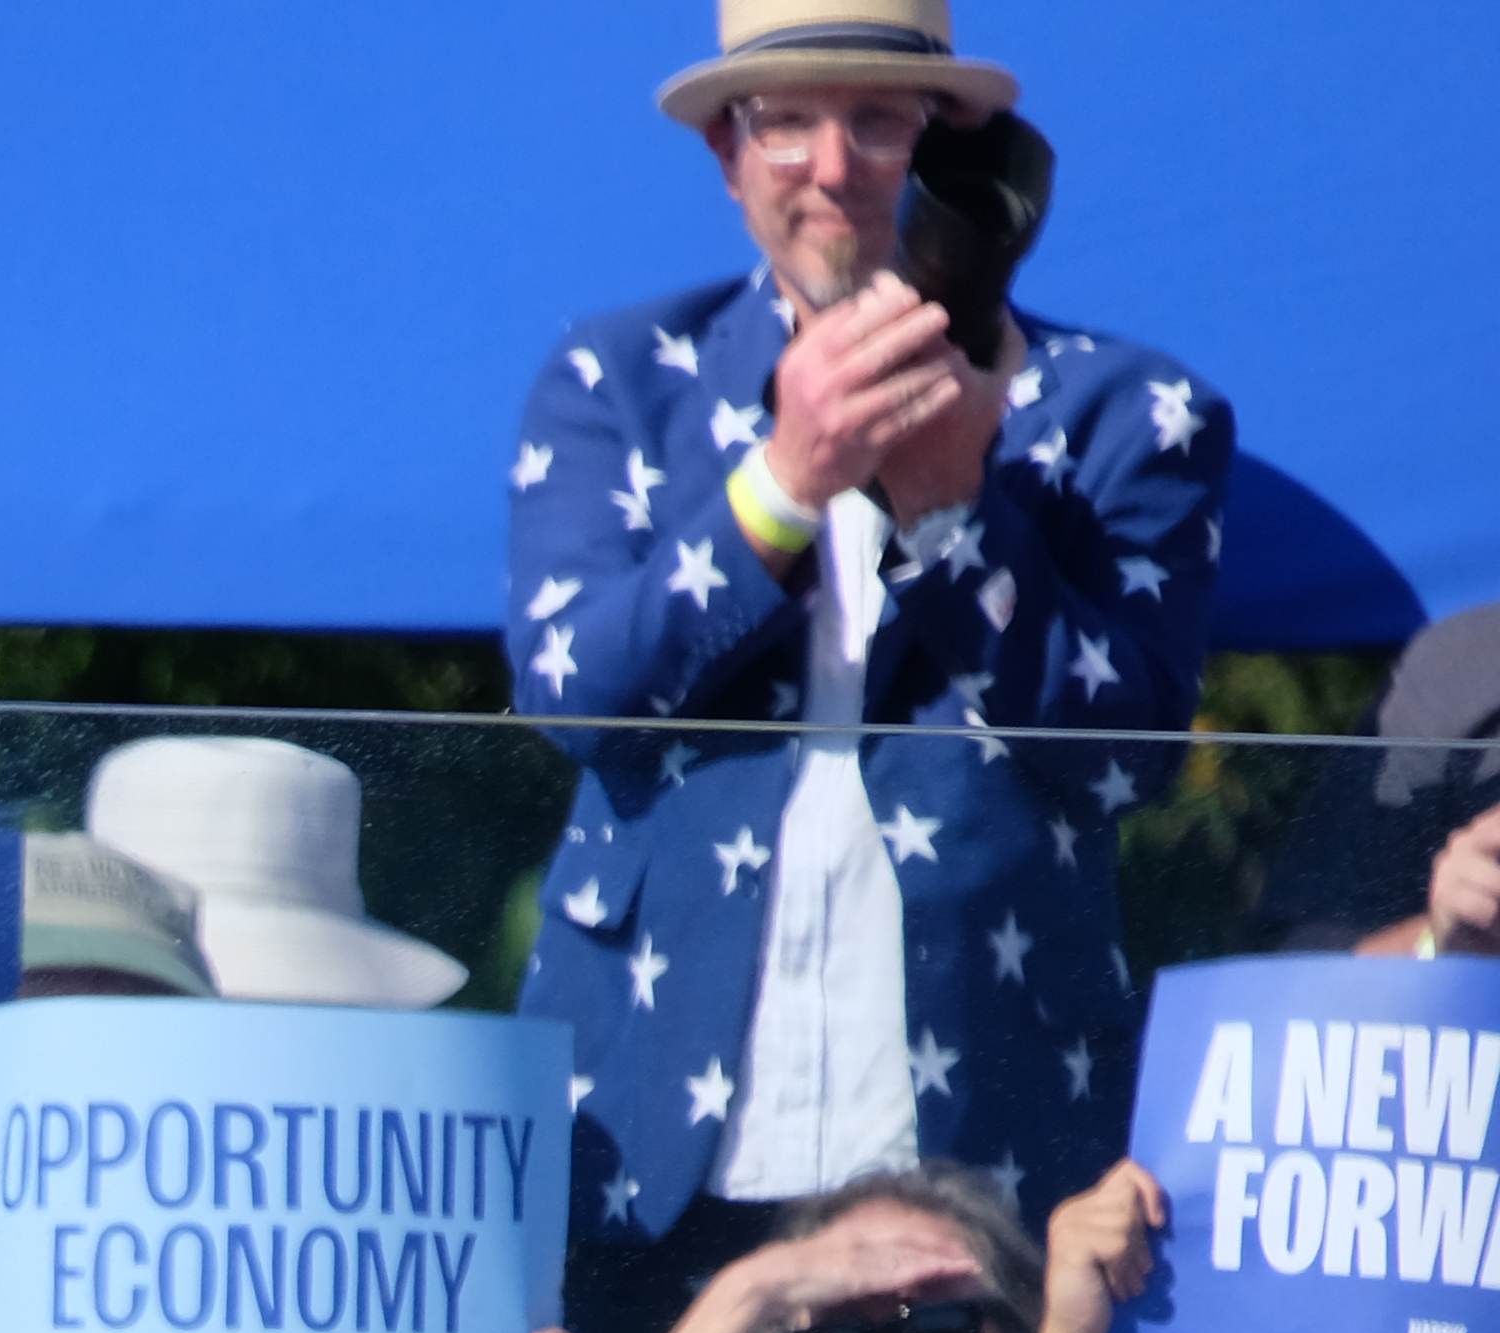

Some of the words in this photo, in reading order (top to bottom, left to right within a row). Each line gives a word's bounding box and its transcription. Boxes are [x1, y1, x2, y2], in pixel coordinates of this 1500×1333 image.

[0, 1101, 535, 1222] OPPORTUNITY
[1186, 1021, 1254, 1144] A
[1274, 1020, 1500, 1163] NEW
[1213, 1150, 1500, 1292] FORW
